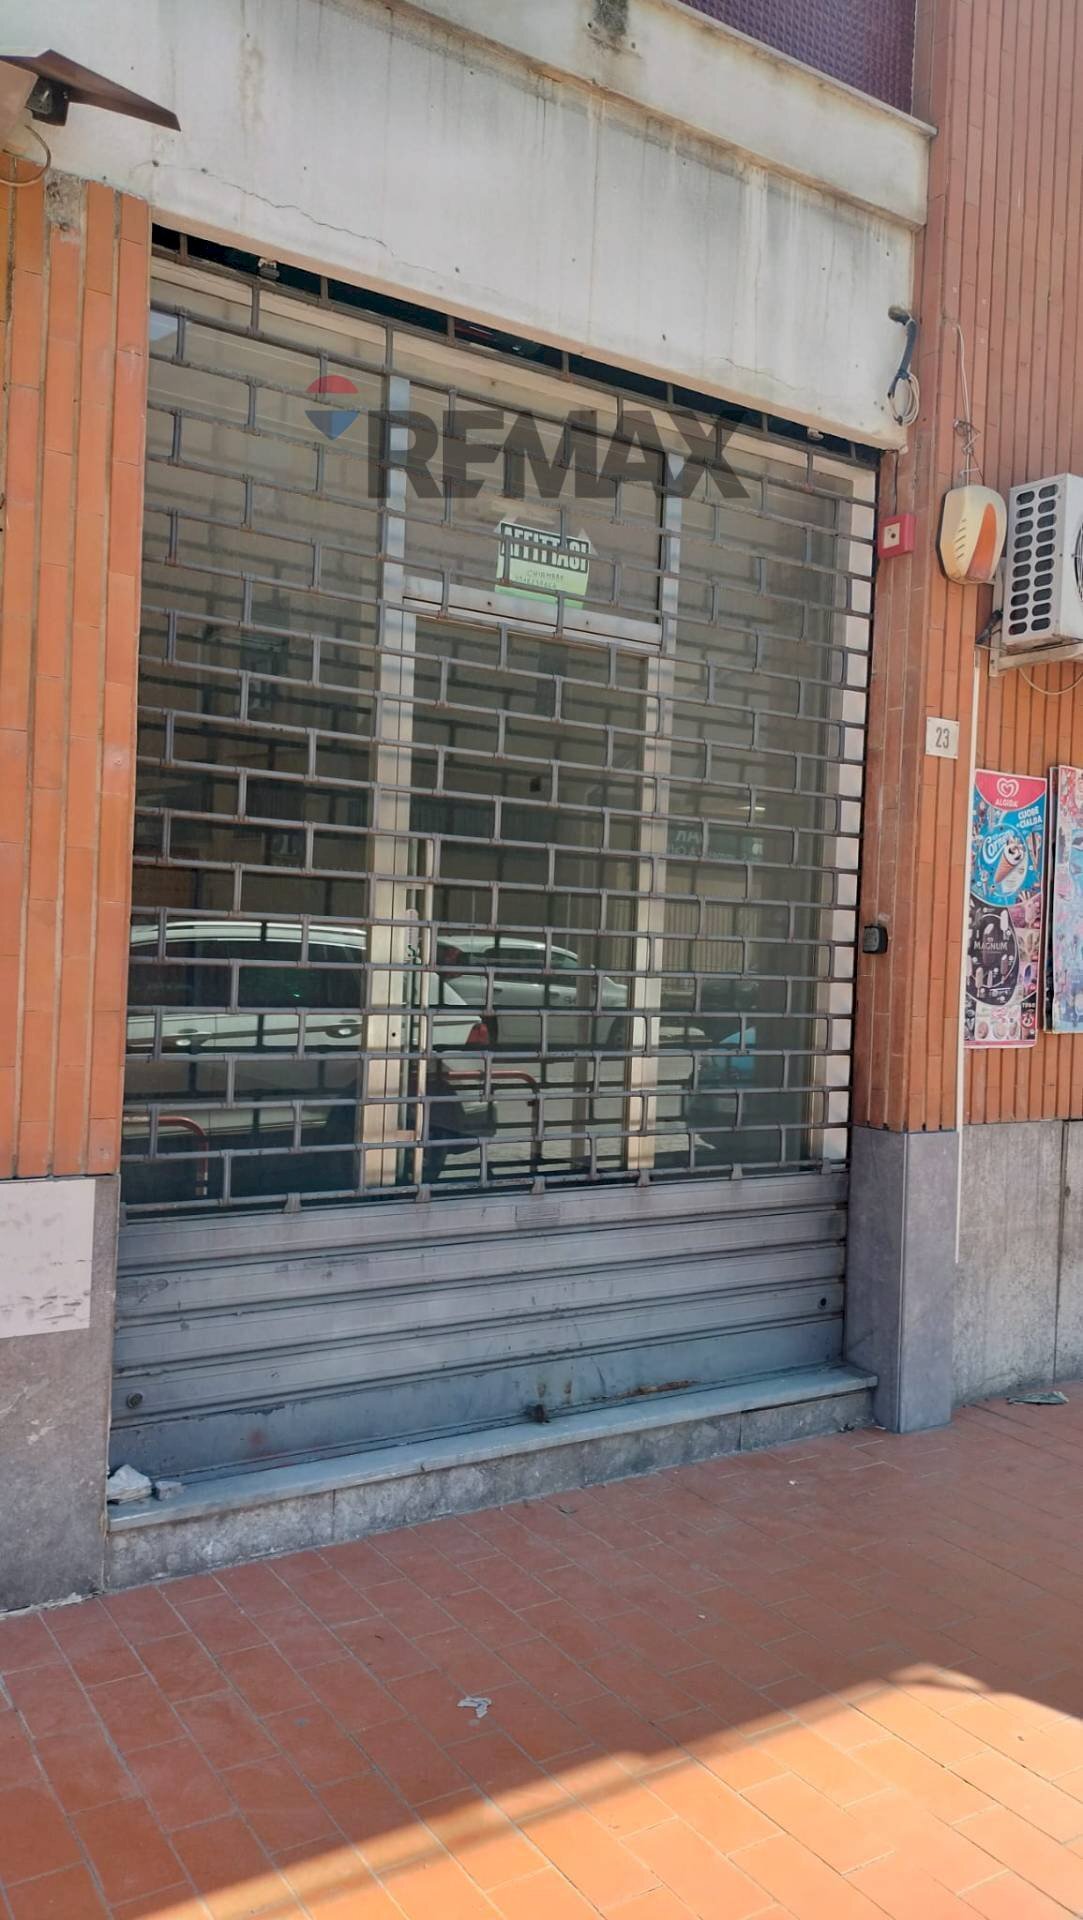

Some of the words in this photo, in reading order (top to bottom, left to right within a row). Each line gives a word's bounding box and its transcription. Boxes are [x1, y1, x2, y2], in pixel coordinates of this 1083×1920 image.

[501, 525, 587, 572] AFFITTASI
[935, 726, 950, 749] 23
[973, 940, 1009, 951] MAGNUM
